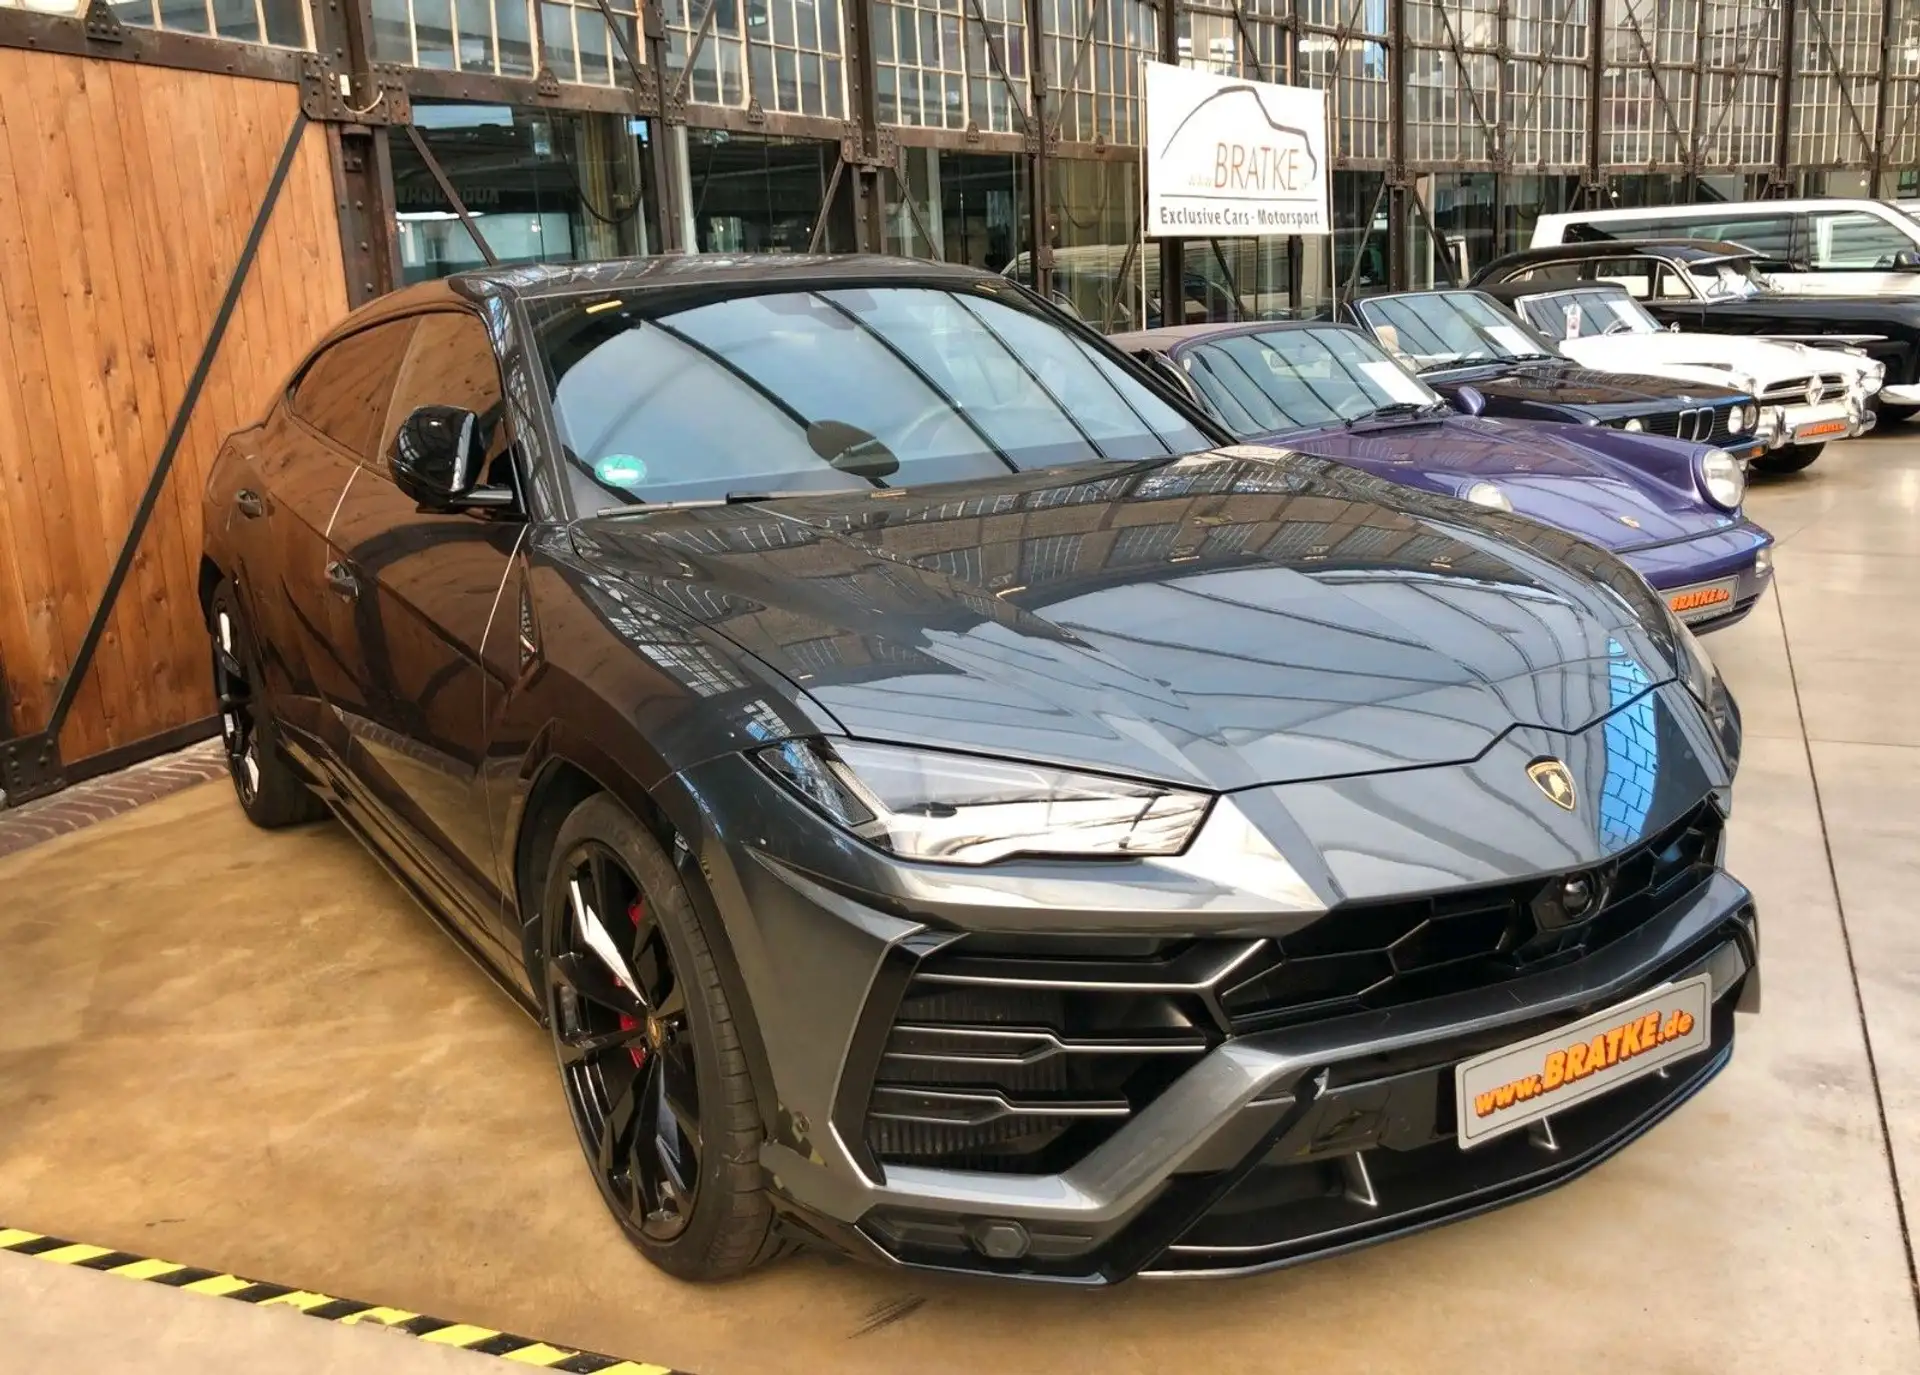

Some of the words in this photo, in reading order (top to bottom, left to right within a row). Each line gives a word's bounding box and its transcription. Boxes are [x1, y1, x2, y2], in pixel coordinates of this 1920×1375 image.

[1160, 206, 1221, 225] Exclusive
[1223, 208, 1250, 226] Cars
[1257, 209, 1319, 229] Motorsport
[1474, 1008, 1695, 1118] www.BRATKE.de
